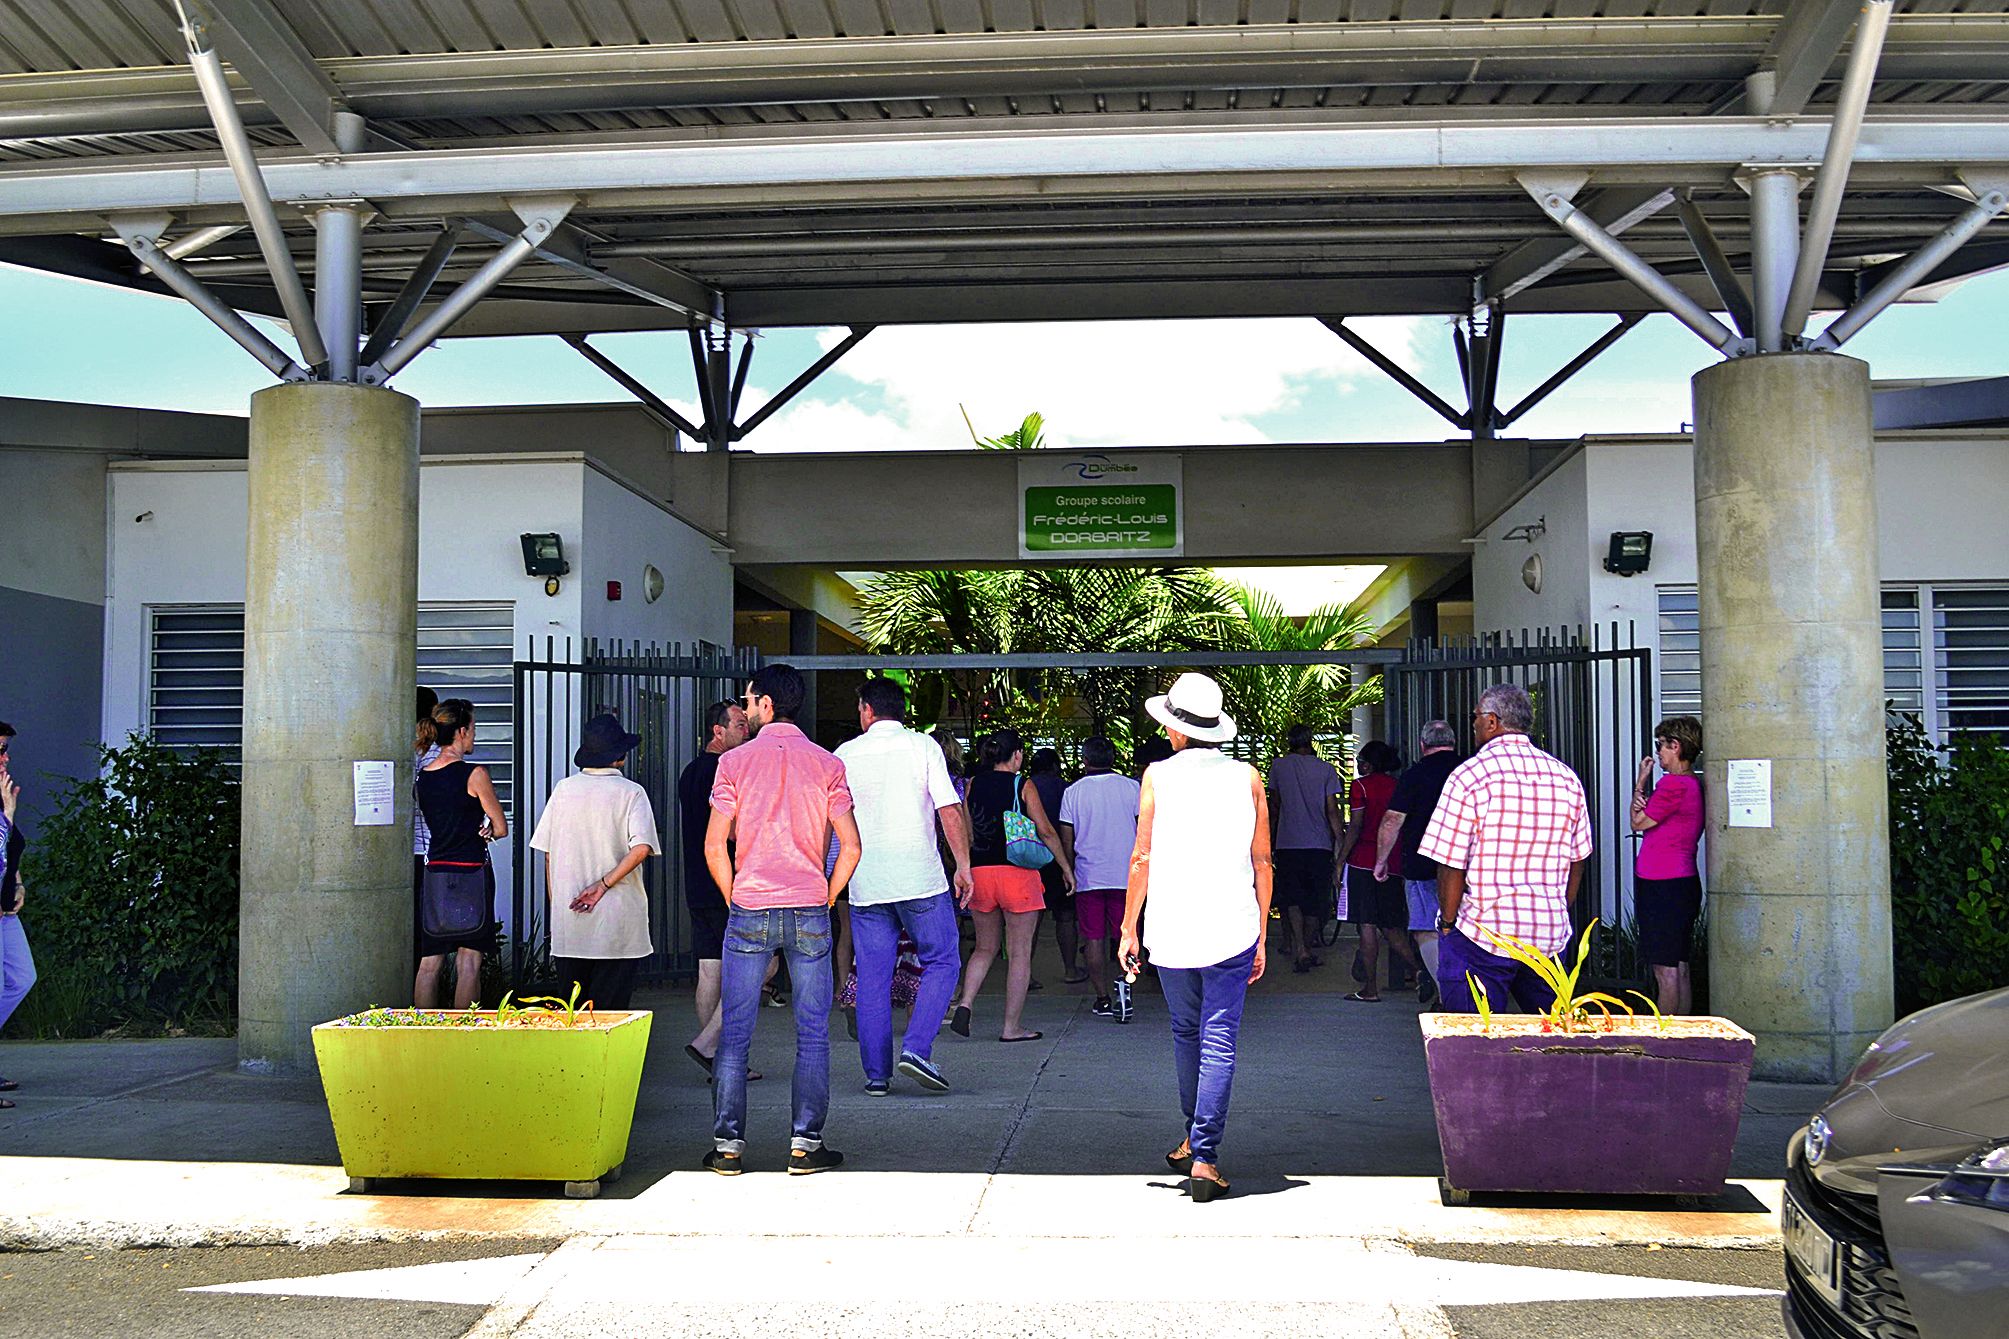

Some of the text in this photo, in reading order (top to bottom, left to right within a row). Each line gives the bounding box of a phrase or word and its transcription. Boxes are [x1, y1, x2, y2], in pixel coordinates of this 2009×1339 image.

[1056, 494, 1146, 508] Groupe scolaire
[1033, 511, 1168, 526] Frédéric-Louis
[1051, 531, 1151, 544] DORBRITZ
